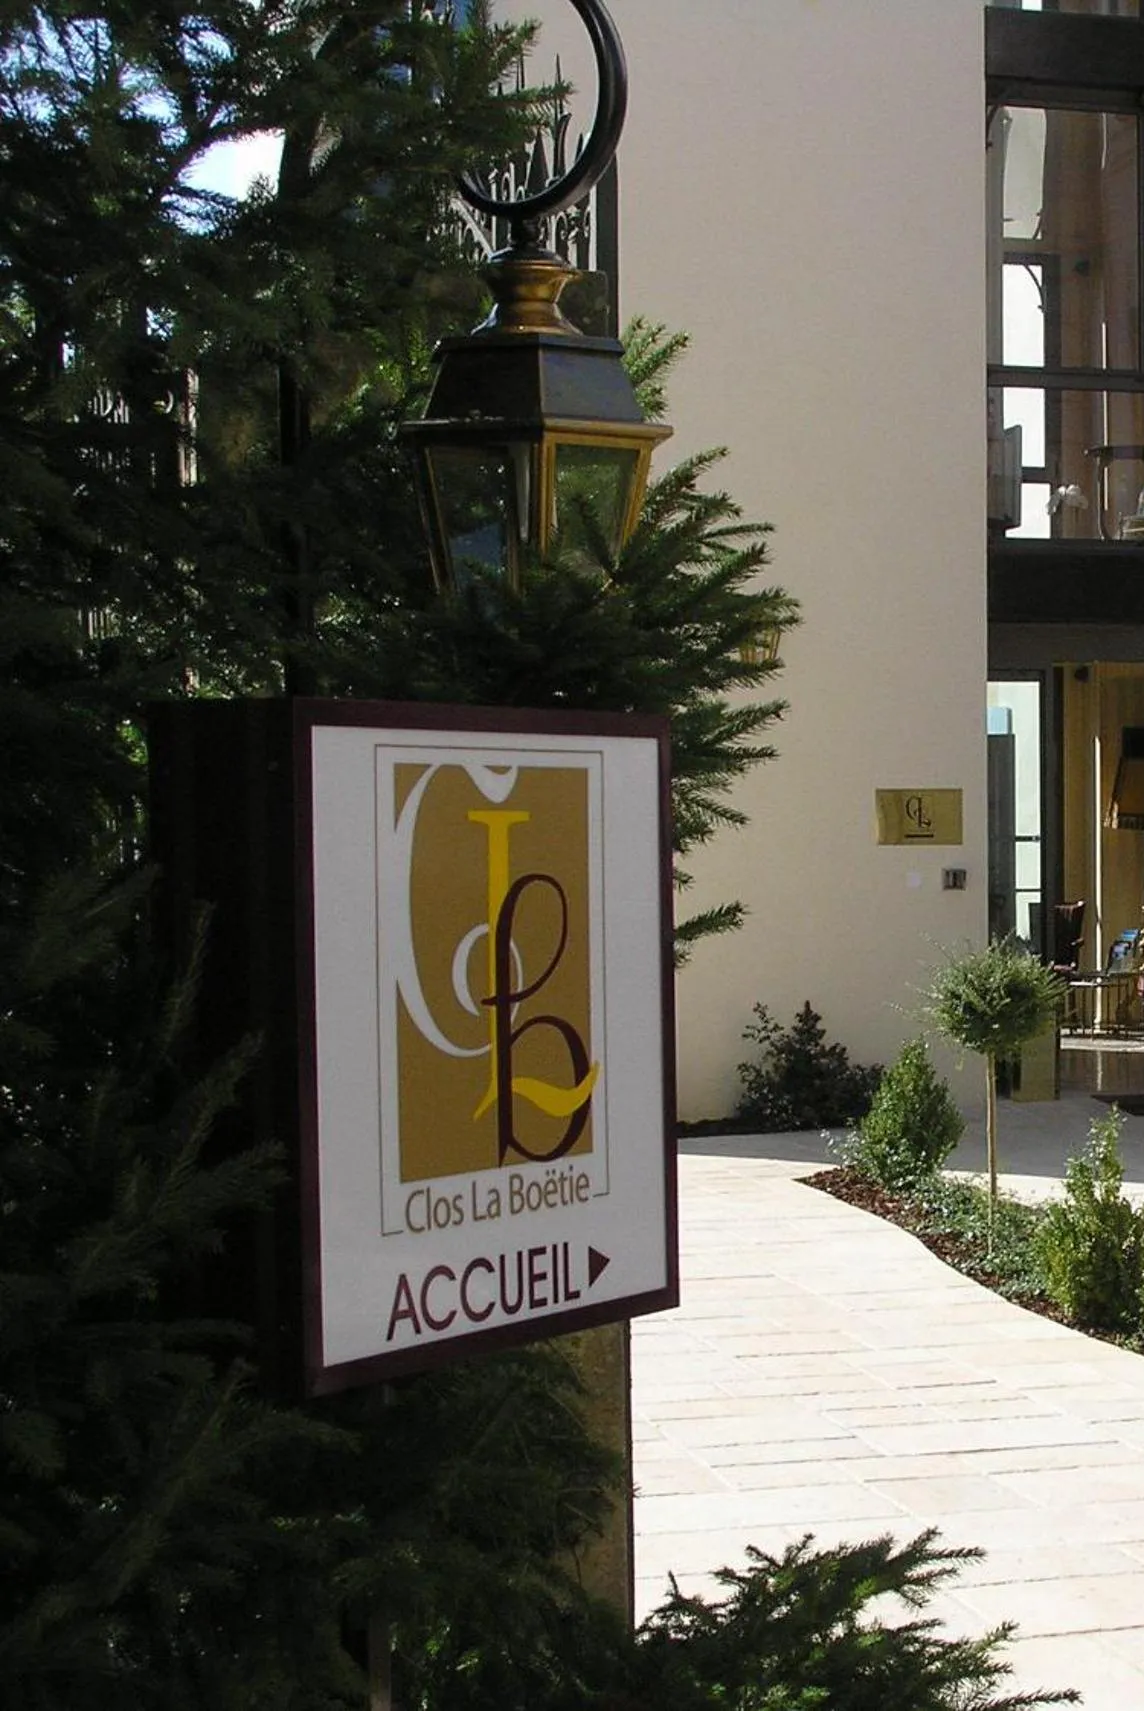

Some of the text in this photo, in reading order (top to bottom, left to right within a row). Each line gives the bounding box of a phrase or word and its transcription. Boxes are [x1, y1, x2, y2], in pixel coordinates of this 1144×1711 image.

[405, 1164, 591, 1234] Clos La Boëtie
[386, 1242, 581, 1343] ACCUEIL
